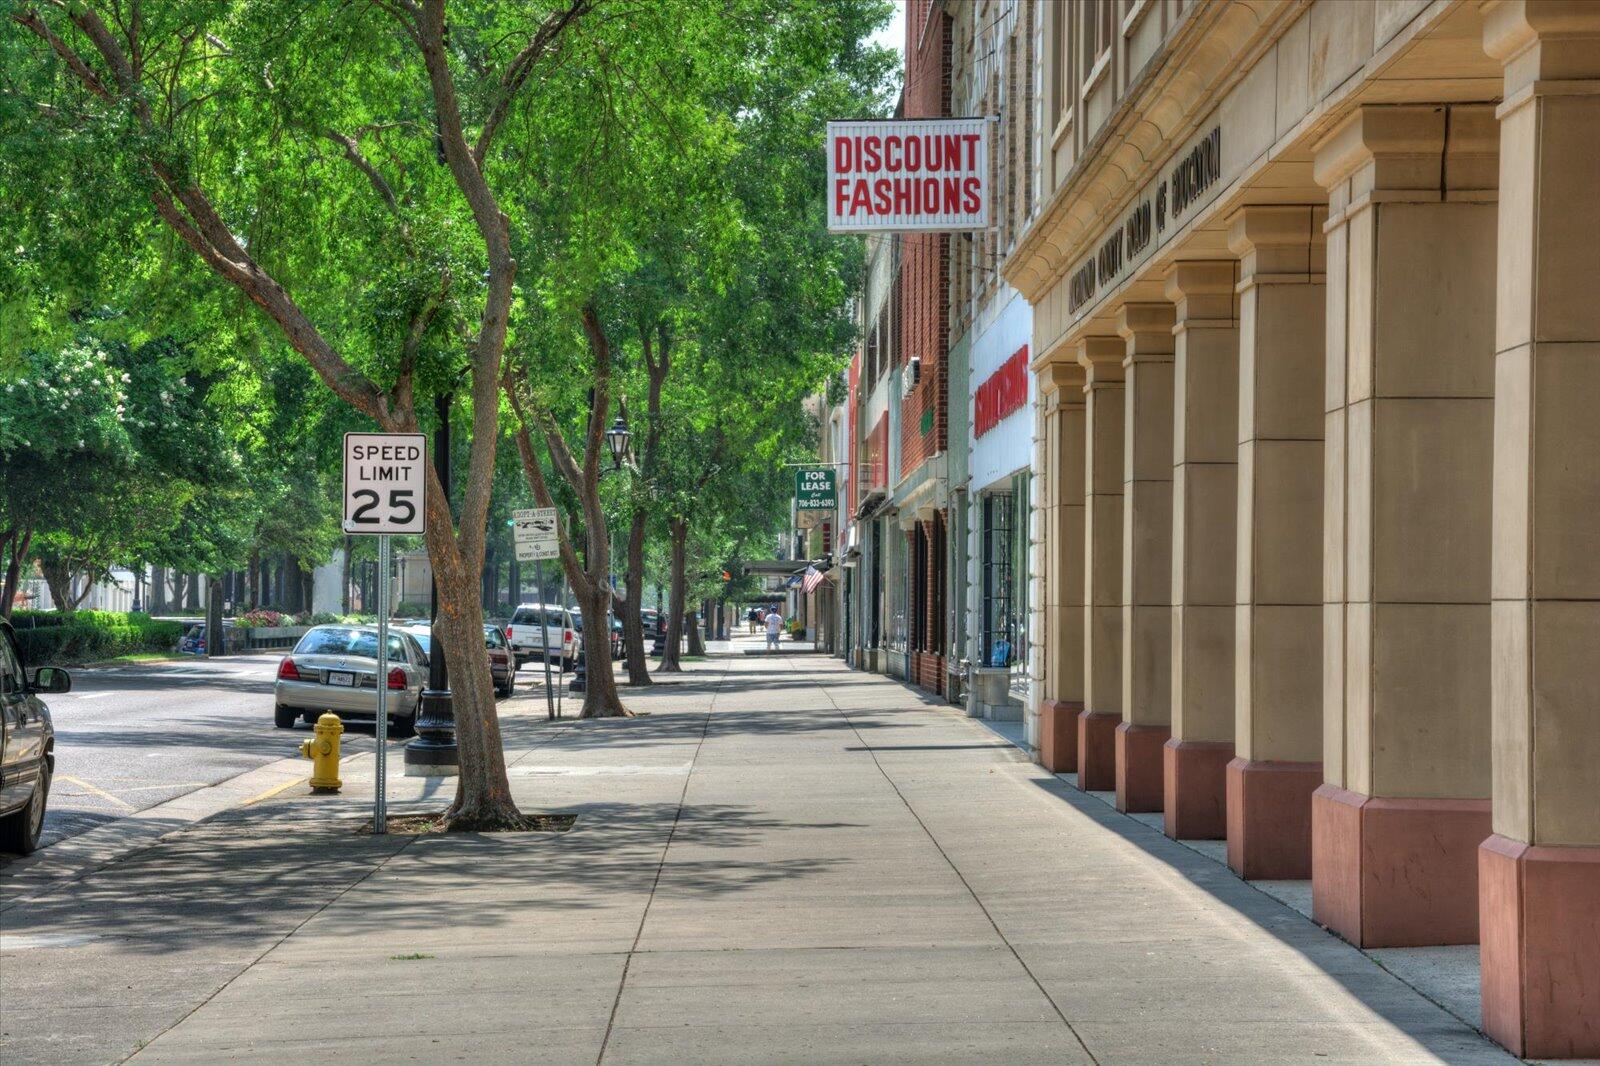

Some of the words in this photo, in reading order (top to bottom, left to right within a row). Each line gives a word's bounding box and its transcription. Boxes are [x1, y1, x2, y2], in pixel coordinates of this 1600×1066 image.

[835, 134, 981, 173] DISCOUNT
[835, 177, 981, 217] FASHIONS
[353, 445, 420, 461] SPEED
[360, 466, 412, 481] LIMIT
[805, 472, 825, 480] FOR
[801, 482, 831, 490] LEASE
[351, 489, 416, 525] 25
